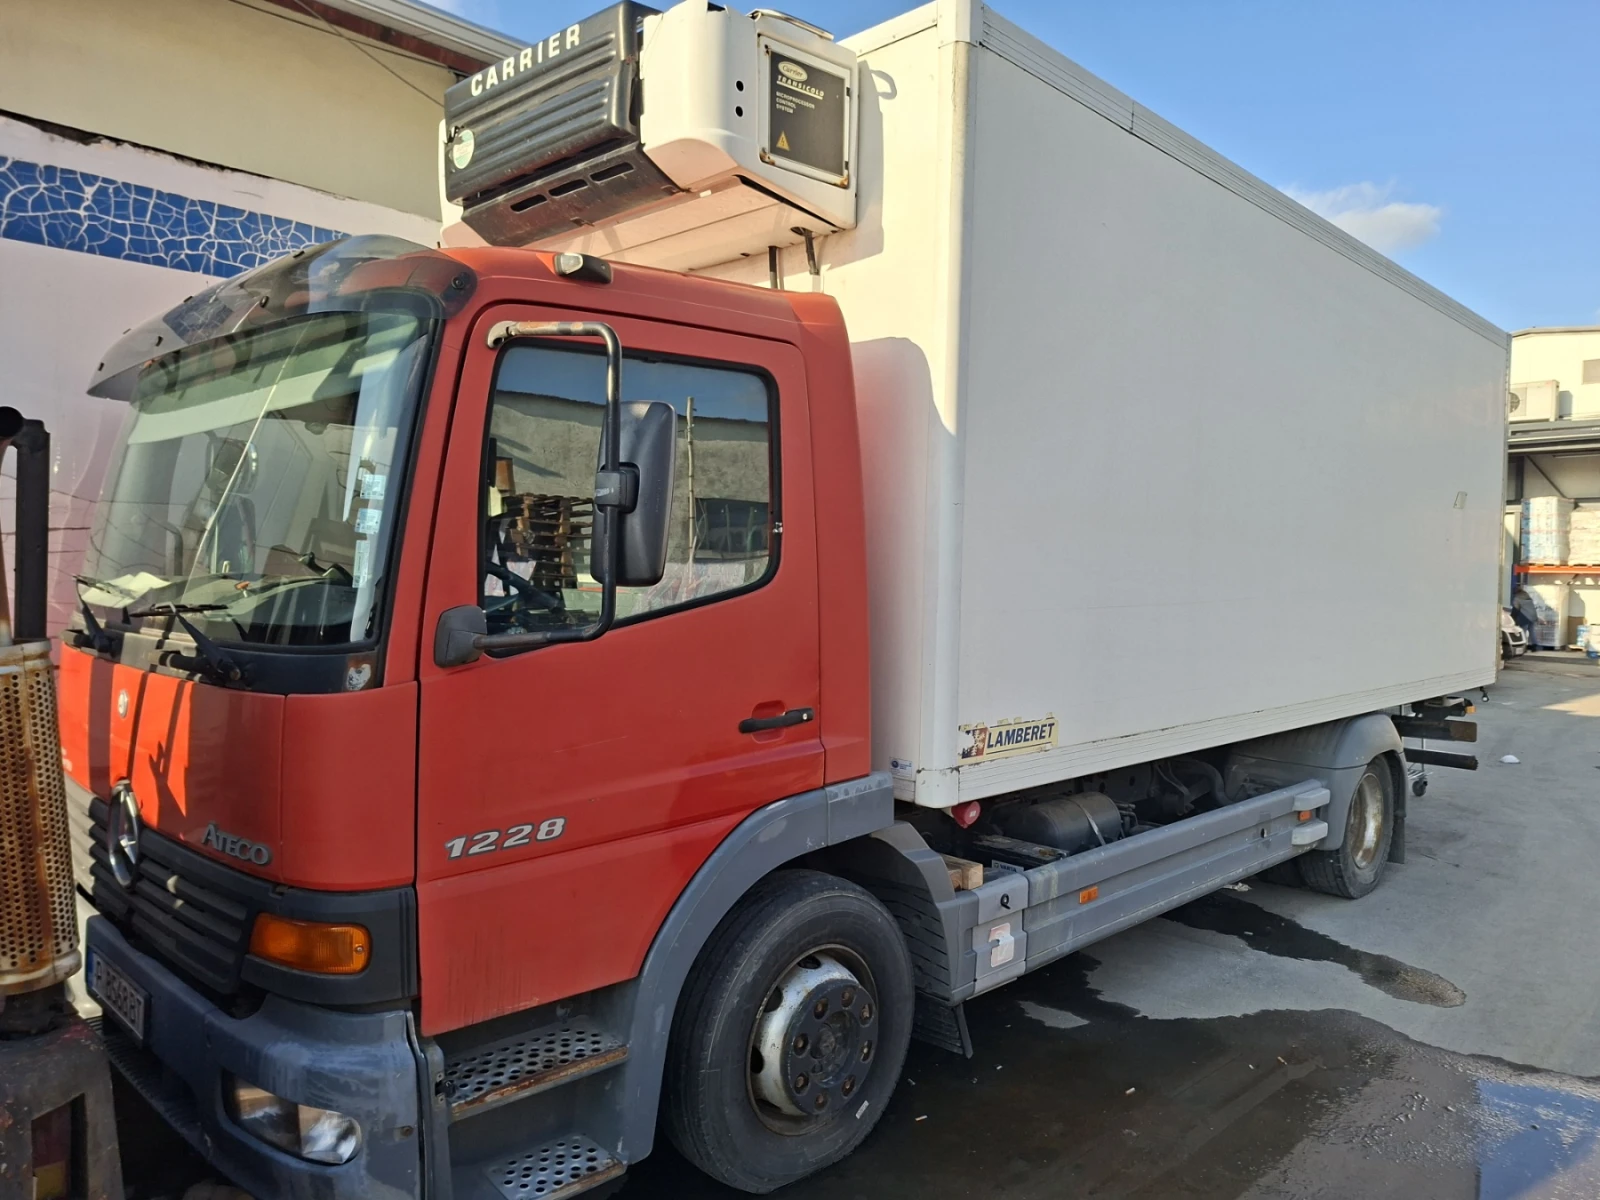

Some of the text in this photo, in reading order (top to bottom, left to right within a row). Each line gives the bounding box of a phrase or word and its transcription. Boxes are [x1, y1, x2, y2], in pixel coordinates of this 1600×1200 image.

[470, 23, 580, 97] CARRIER
[782, 64, 804, 78] Carrier
[777, 74, 825, 97] TRANSICOLD
[776, 91, 815, 110] MICROPROCESSOR
[776, 97, 797, 109] CONTROL
[776, 103, 794, 114] SYSTEM
[986, 722, 1055, 749] LAMBERET
[201, 822, 273, 866] ATECO
[445, 816, 567, 859] 1228
